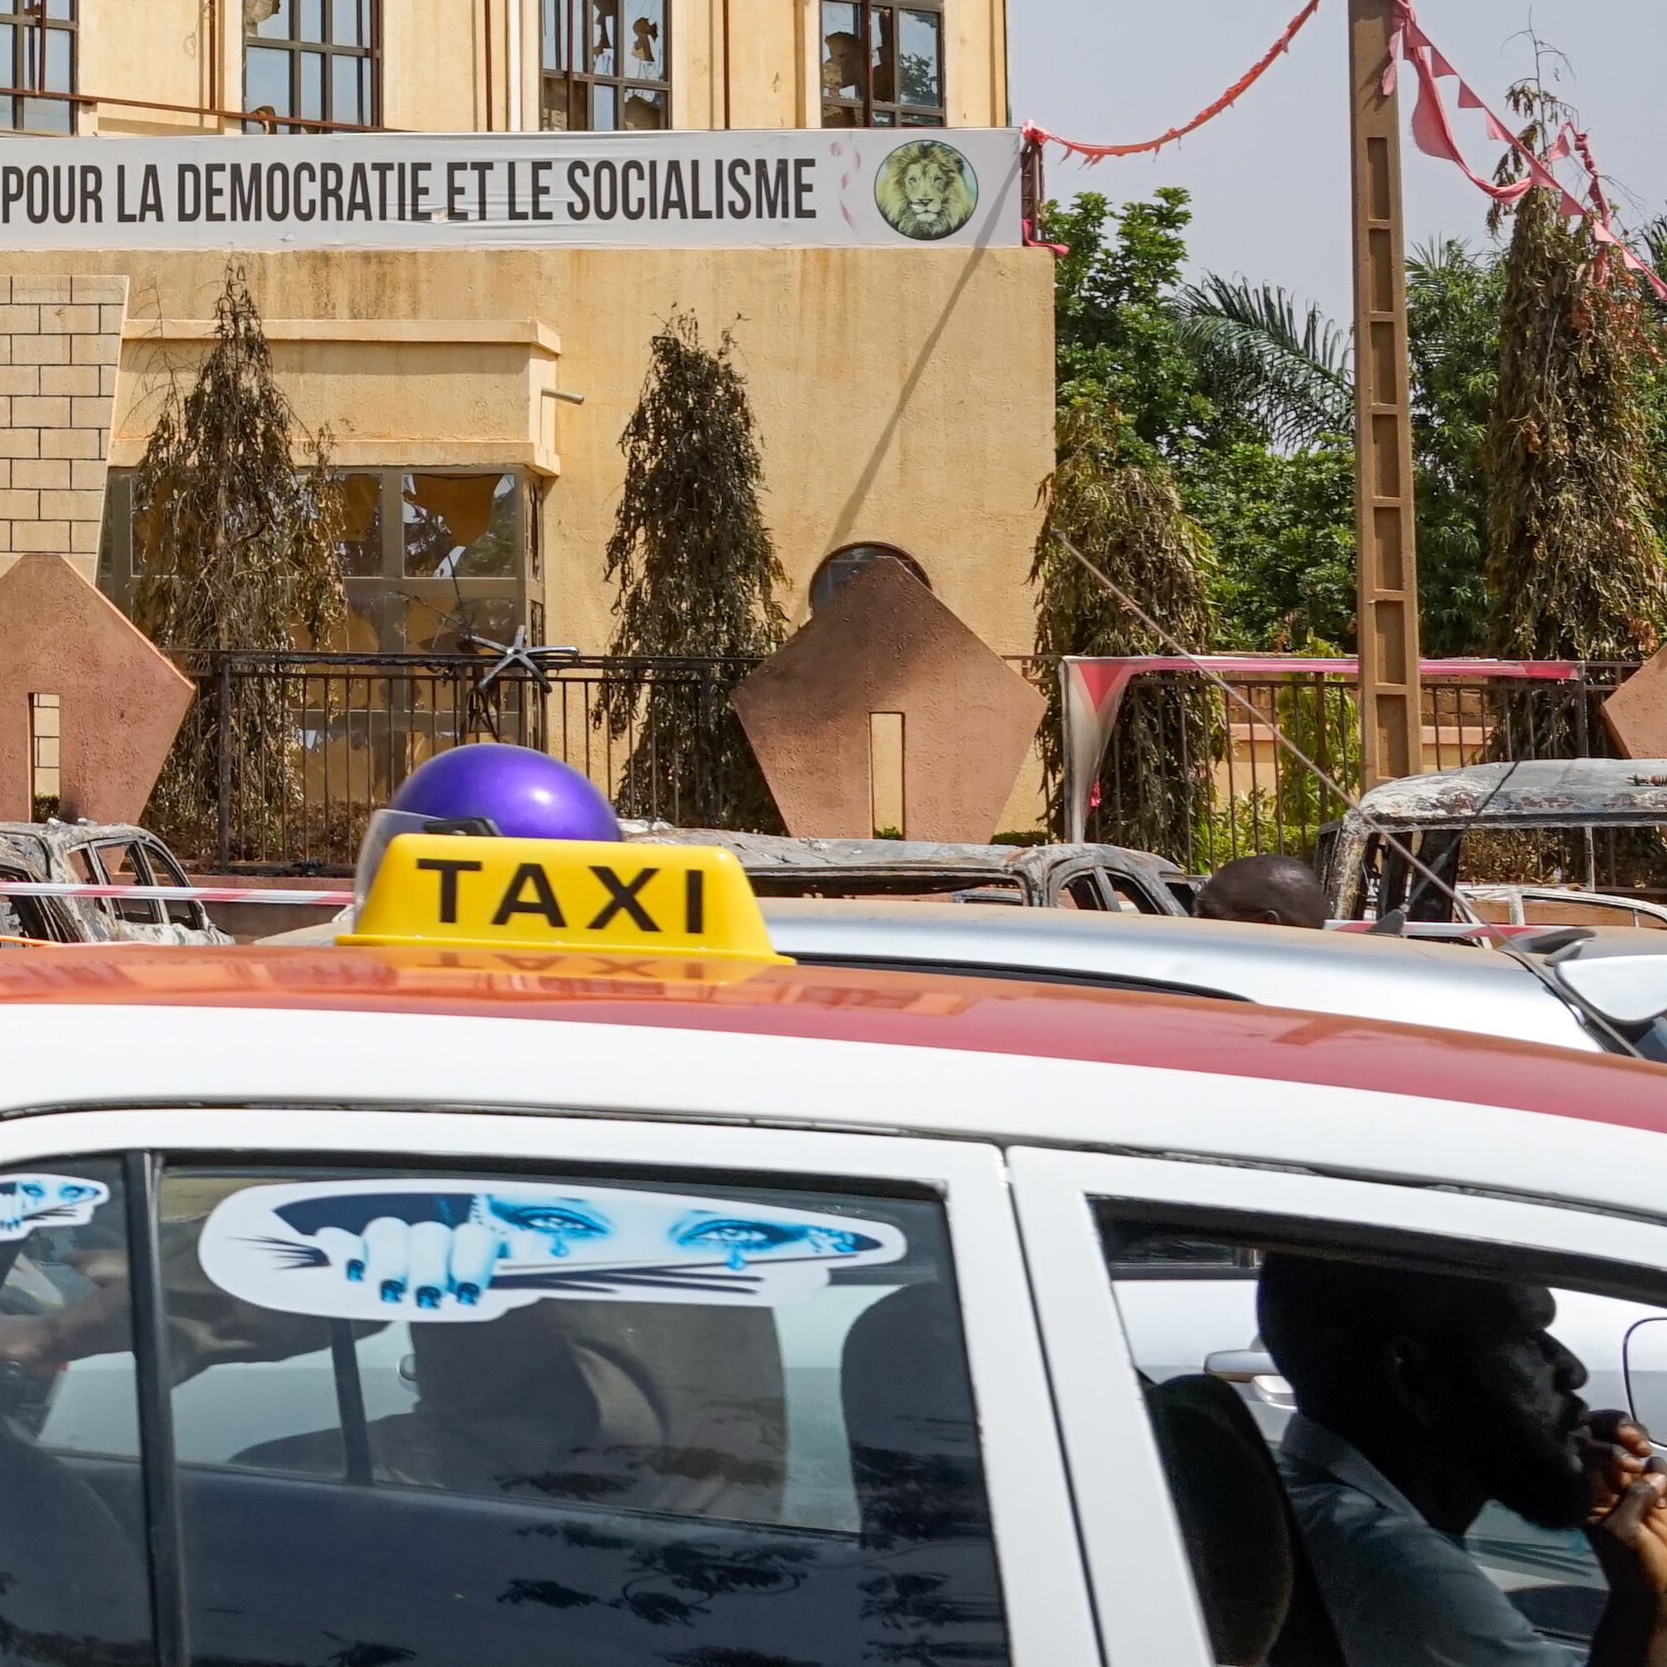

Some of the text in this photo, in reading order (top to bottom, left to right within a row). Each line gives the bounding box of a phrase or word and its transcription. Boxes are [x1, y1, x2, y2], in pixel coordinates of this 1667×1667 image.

[2, 165, 105, 224] POUR
[117, 163, 165, 223] LA
[178, 161, 431, 223] DEMOCRATIE
[446, 161, 495, 222] ET
[507, 160, 553, 221] LE
[565, 158, 817, 222] SOCIALISME
[415, 857, 705, 935] TAXI
